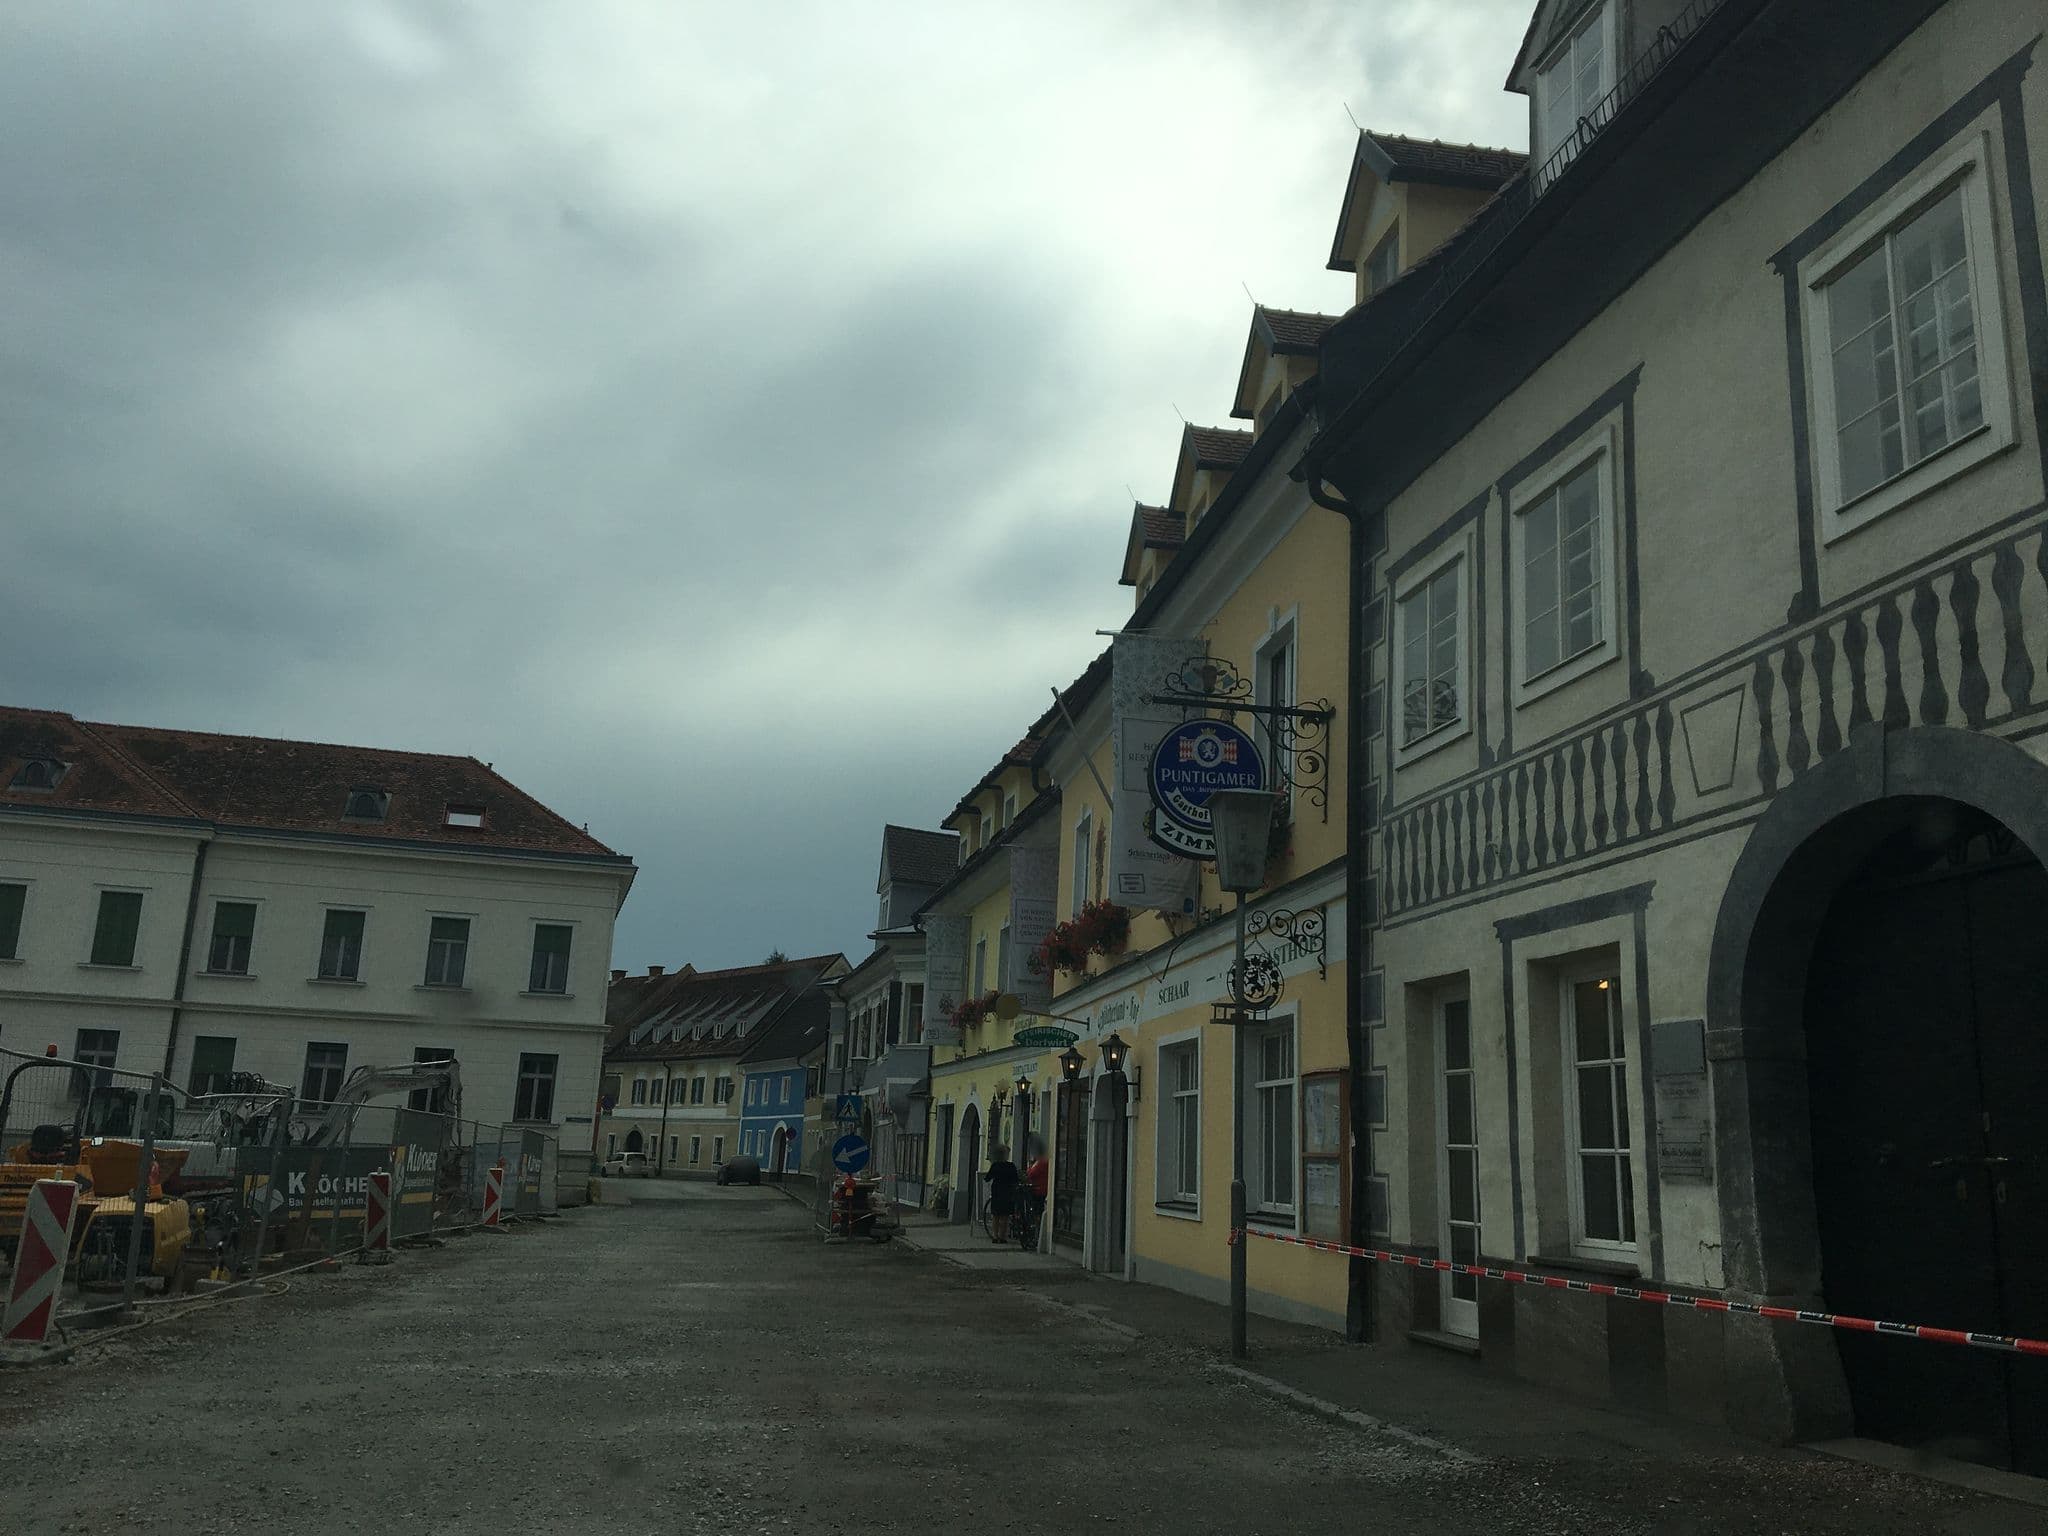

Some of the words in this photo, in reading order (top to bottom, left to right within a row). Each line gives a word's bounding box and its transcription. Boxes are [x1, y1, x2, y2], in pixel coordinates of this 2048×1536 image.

[1160, 767, 1256, 786] PUNTIGAMER
[1173, 794, 1209, 820] Gasthof
[1158, 980, 1190, 1006] SCHAAR
[1025, 1038, 1069, 1047] Dorfwirt
